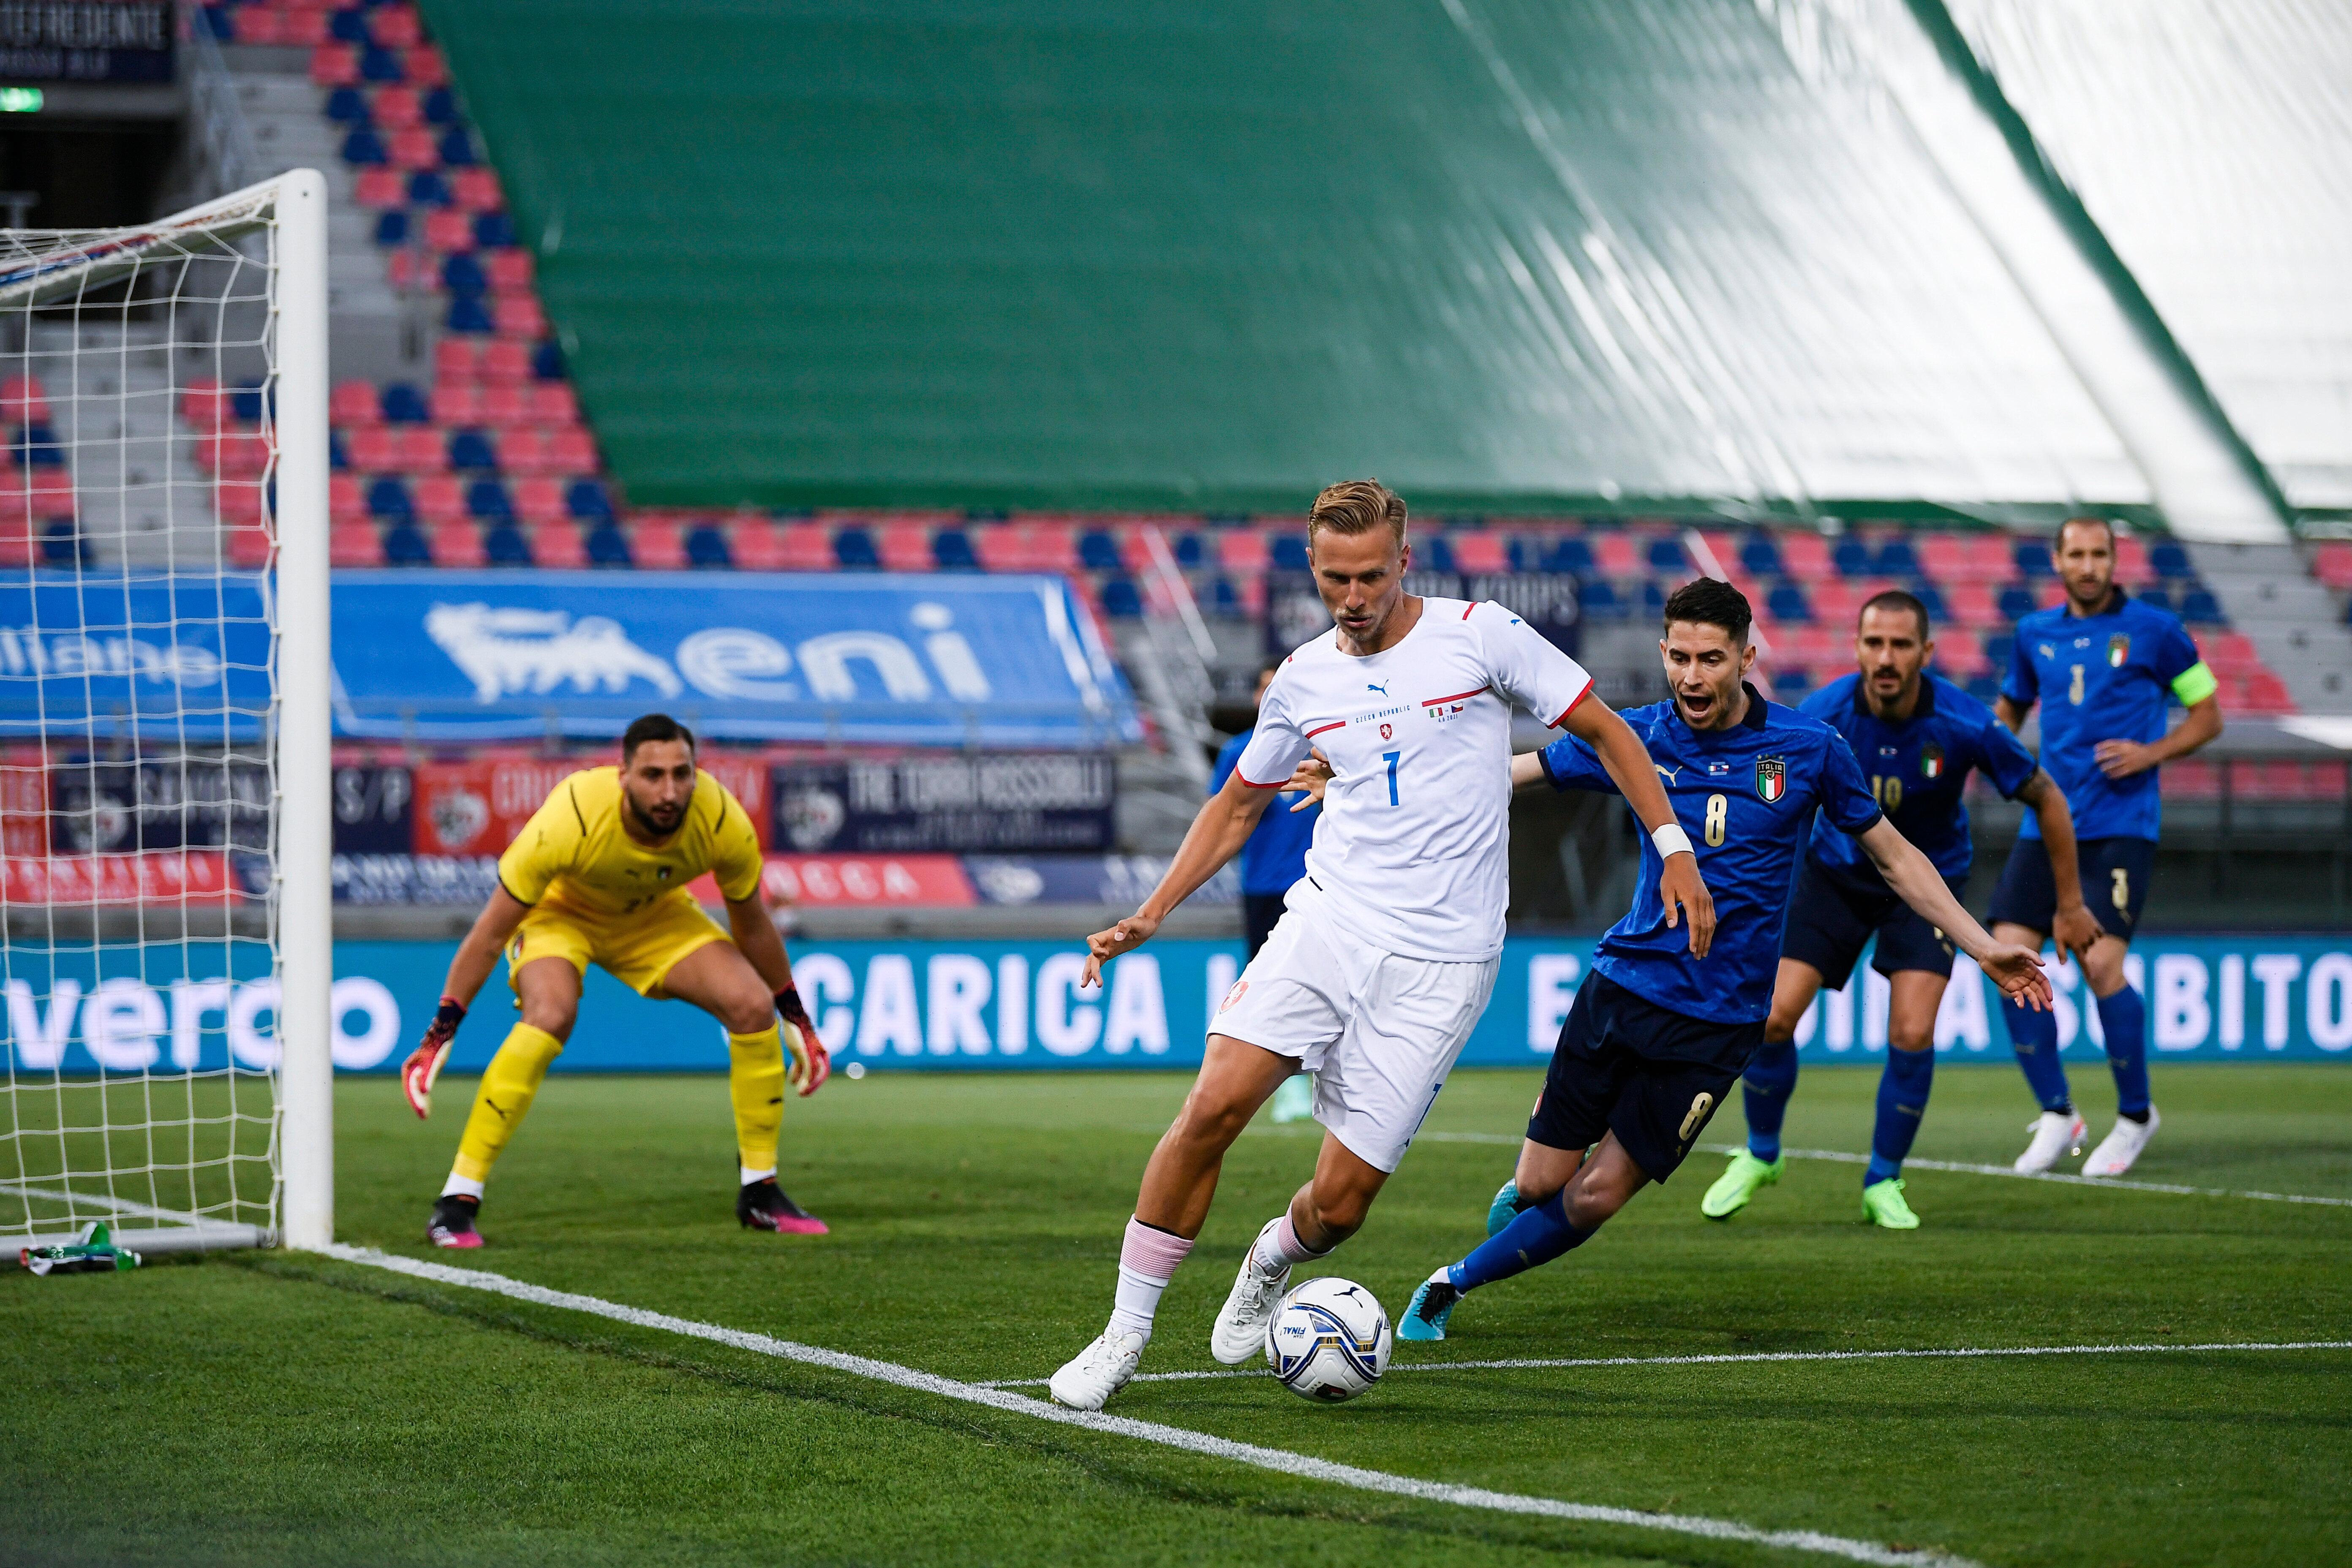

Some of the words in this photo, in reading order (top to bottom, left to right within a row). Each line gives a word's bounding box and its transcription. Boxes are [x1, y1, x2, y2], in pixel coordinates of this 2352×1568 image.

[676, 602, 992, 702] eni
[1356, 714, 1375, 723] CZECH
[1379, 705, 1410, 717] REPUBLIC
[1383, 751, 1400, 806] 7
[1705, 794, 1727, 847] 8
[721, 953, 1170, 1057] CARICA
[1679, 1092, 1713, 1141] 8
[1283, 1327, 1306, 1335] FINAL
